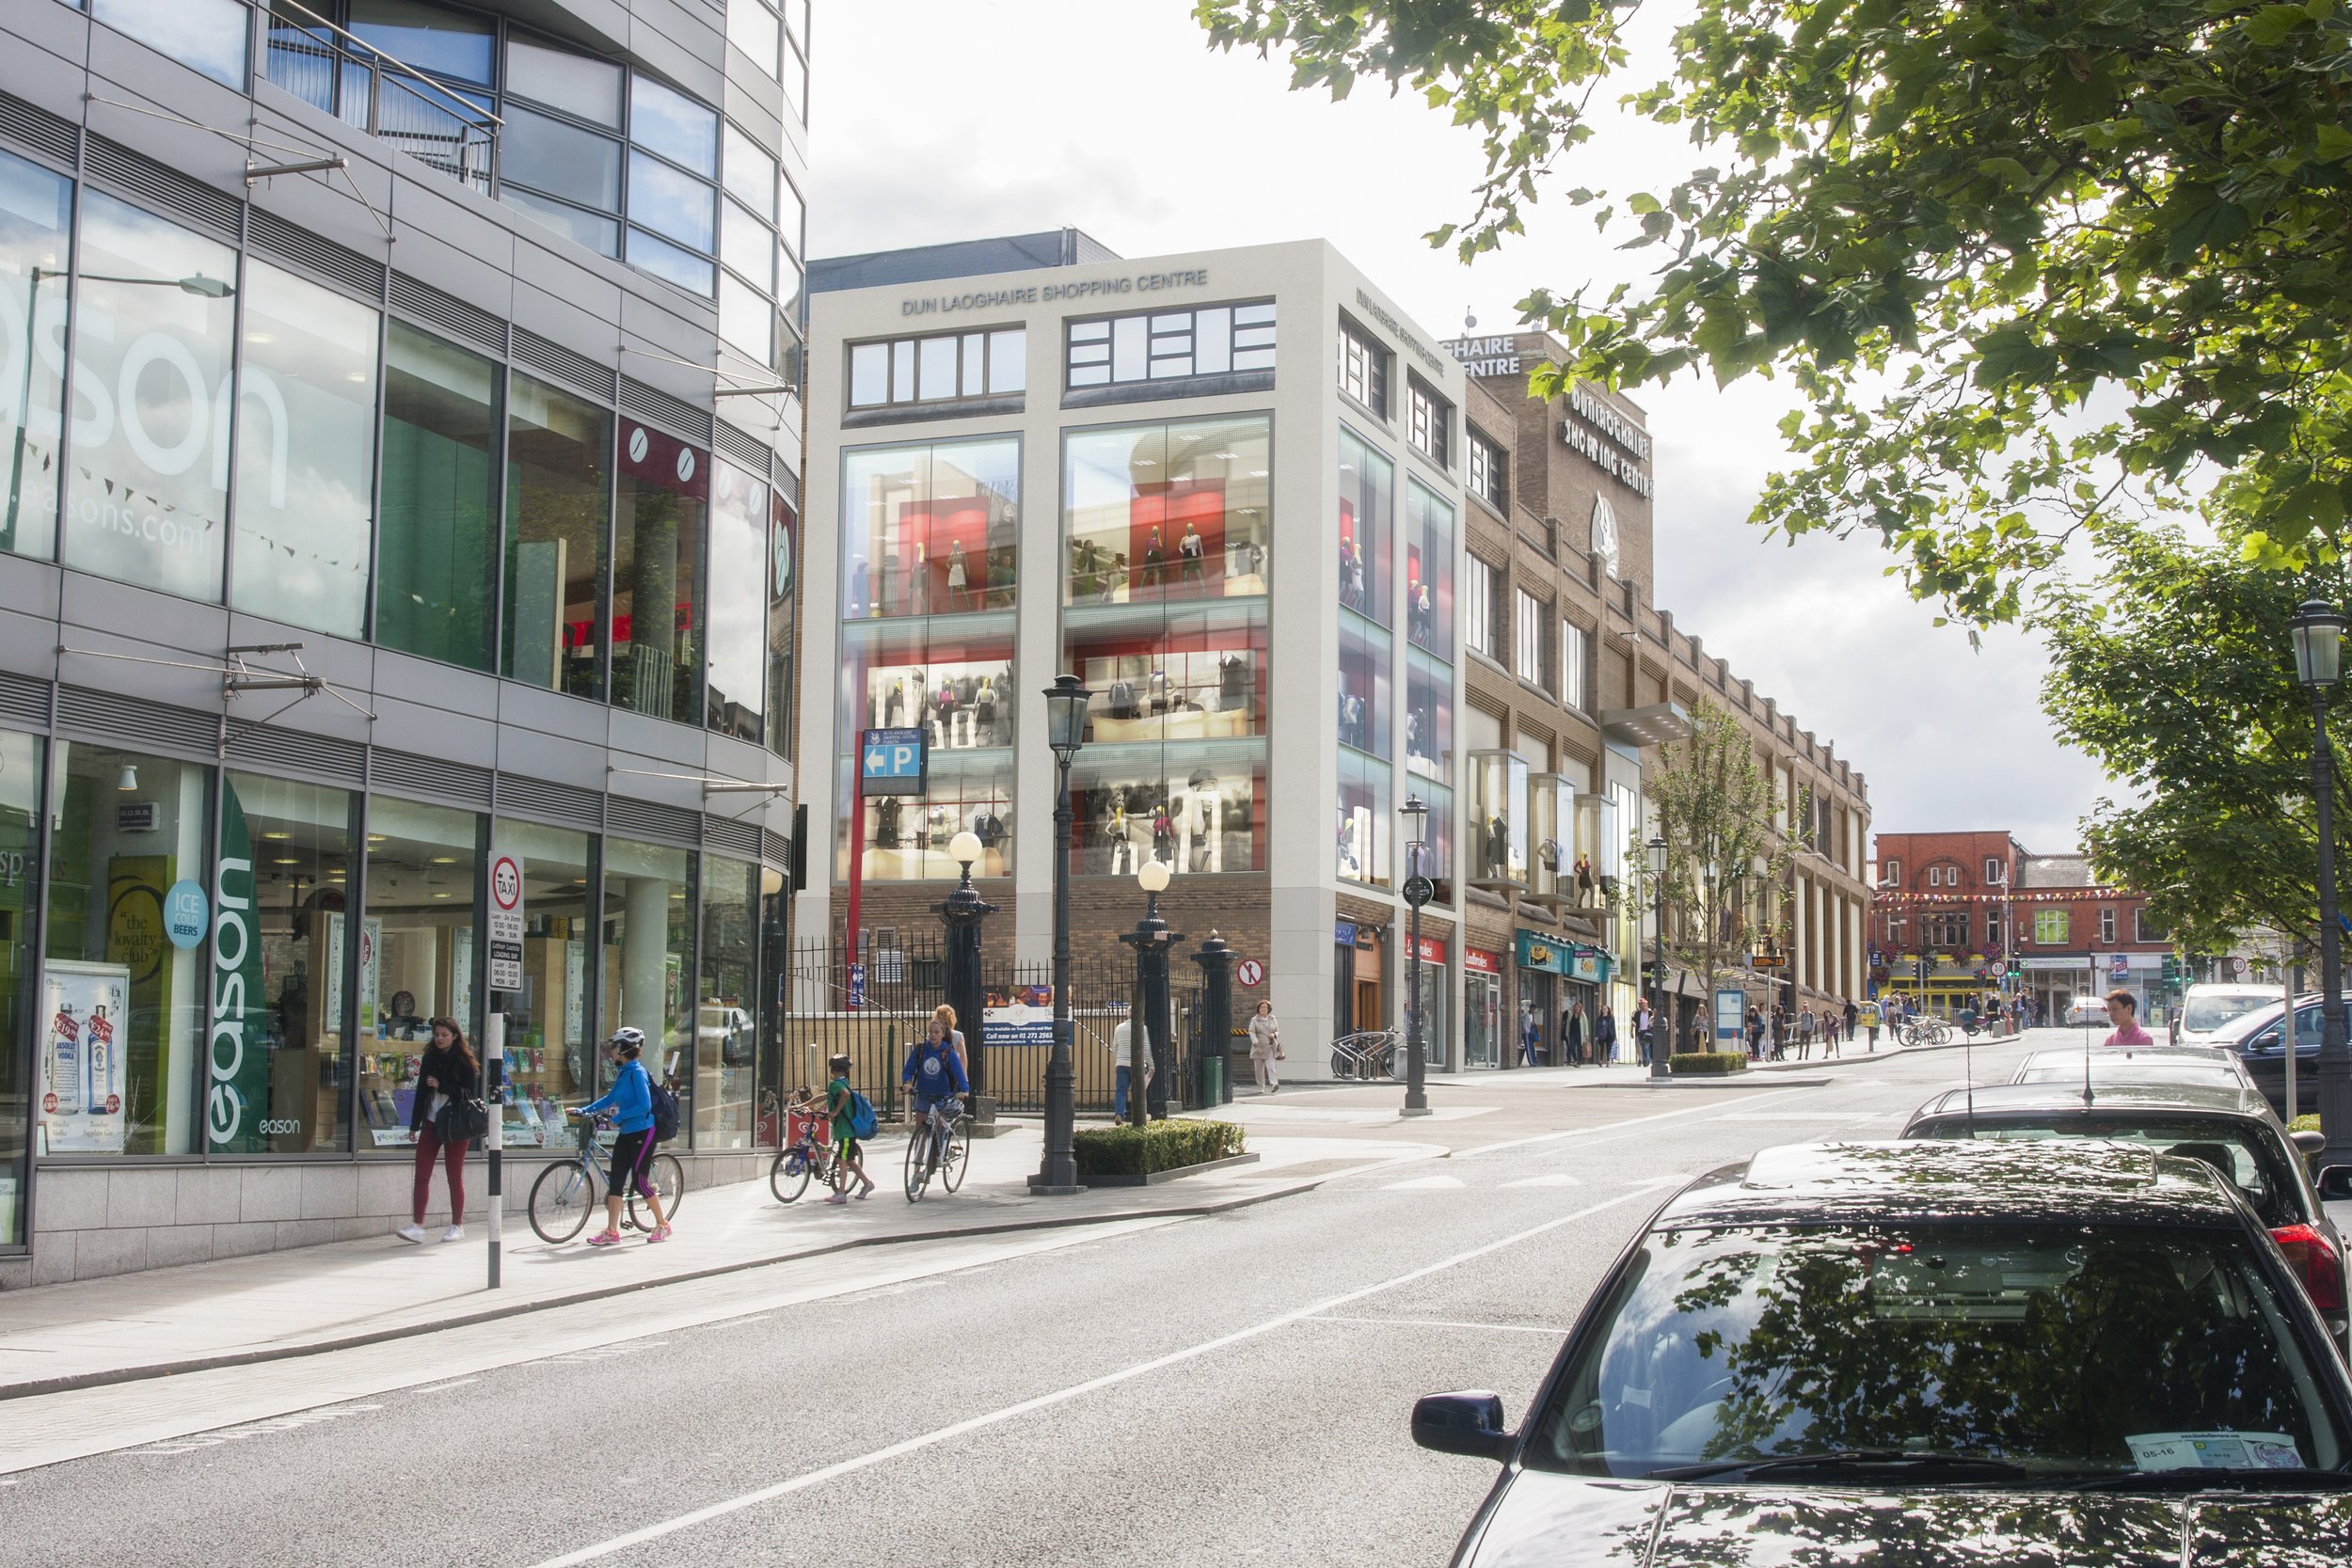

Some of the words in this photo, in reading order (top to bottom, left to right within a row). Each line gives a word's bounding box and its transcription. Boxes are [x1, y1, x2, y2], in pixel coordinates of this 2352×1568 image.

[901, 297, 937, 316] DUN
[942, 287, 1035, 312] LAOGHAIRE
[1041, 277, 1131, 301] SHOPPING
[1136, 269, 1207, 292] CENTRE
[1565, 419, 1617, 476] SHOPPING
[1621, 458, 1654, 501] CENTRE
[894, 746, 913, 774] P
[498, 880, 516, 895] TAXI
[175, 893, 199, 914] ICE
[174, 912, 199, 926] COLD
[114, 931, 157, 947] loyalty
[173, 925, 199, 937] BEERS
[494, 950, 510, 959] LOADING
[1465, 950, 1487, 968] Ladbrokes
[209, 857, 251, 1145] eason
[56, 1041, 76, 1050] ABSOLUT
[259, 1119, 300, 1134] eason
[2142, 1448, 2175, 1459] 05-16
